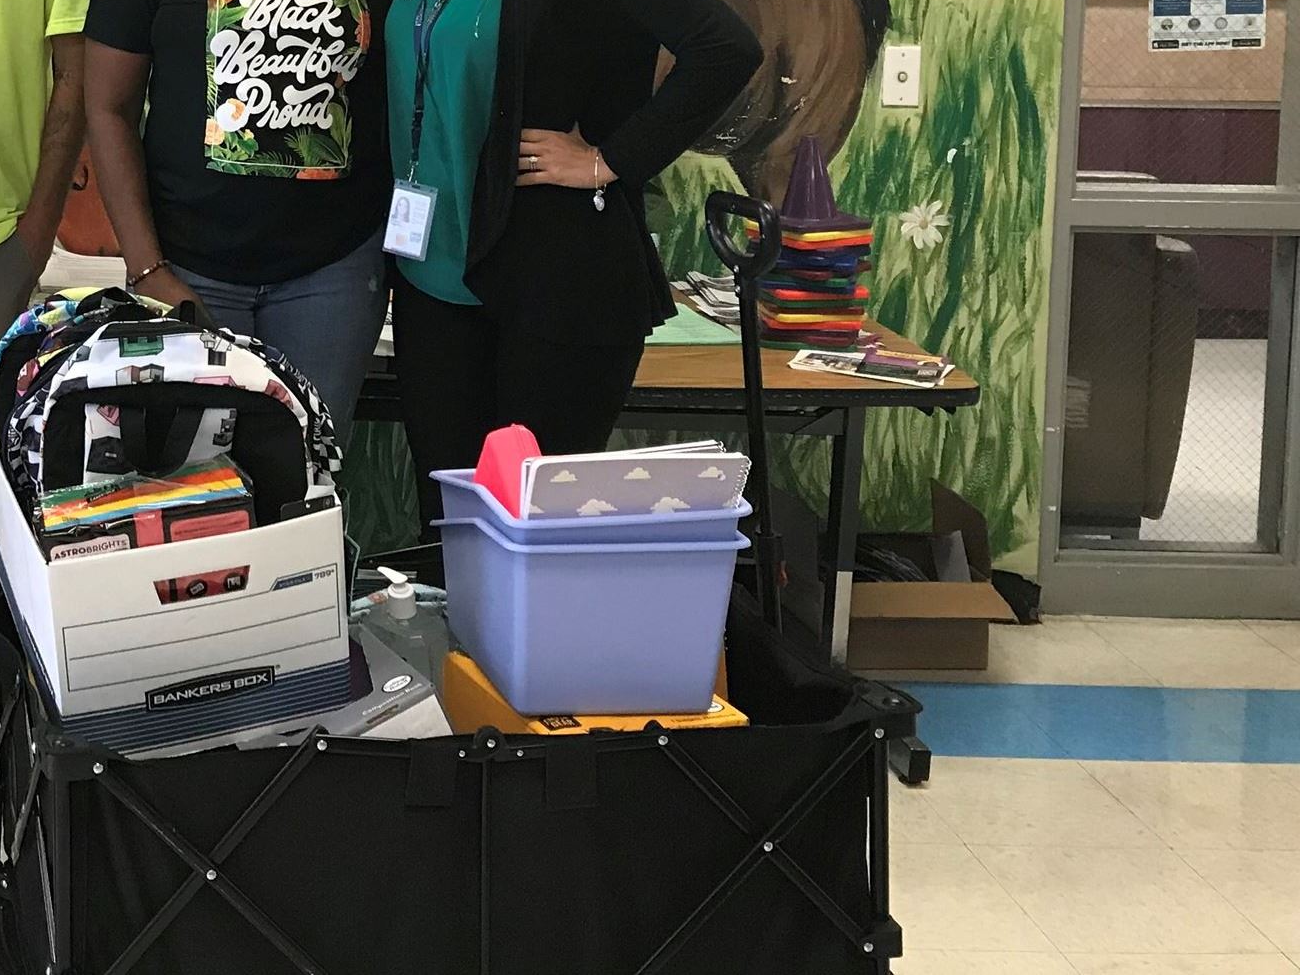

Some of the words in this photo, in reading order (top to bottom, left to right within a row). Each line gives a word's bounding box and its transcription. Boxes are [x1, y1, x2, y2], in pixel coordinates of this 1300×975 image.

[210, 30, 362, 85] Beautiful
[216, 78, 334, 132] Proud
[54, 540, 127, 562] ASTROBRIGHTS
[153, 681, 232, 705] BANKERS
[234, 673, 269, 688] BOX
